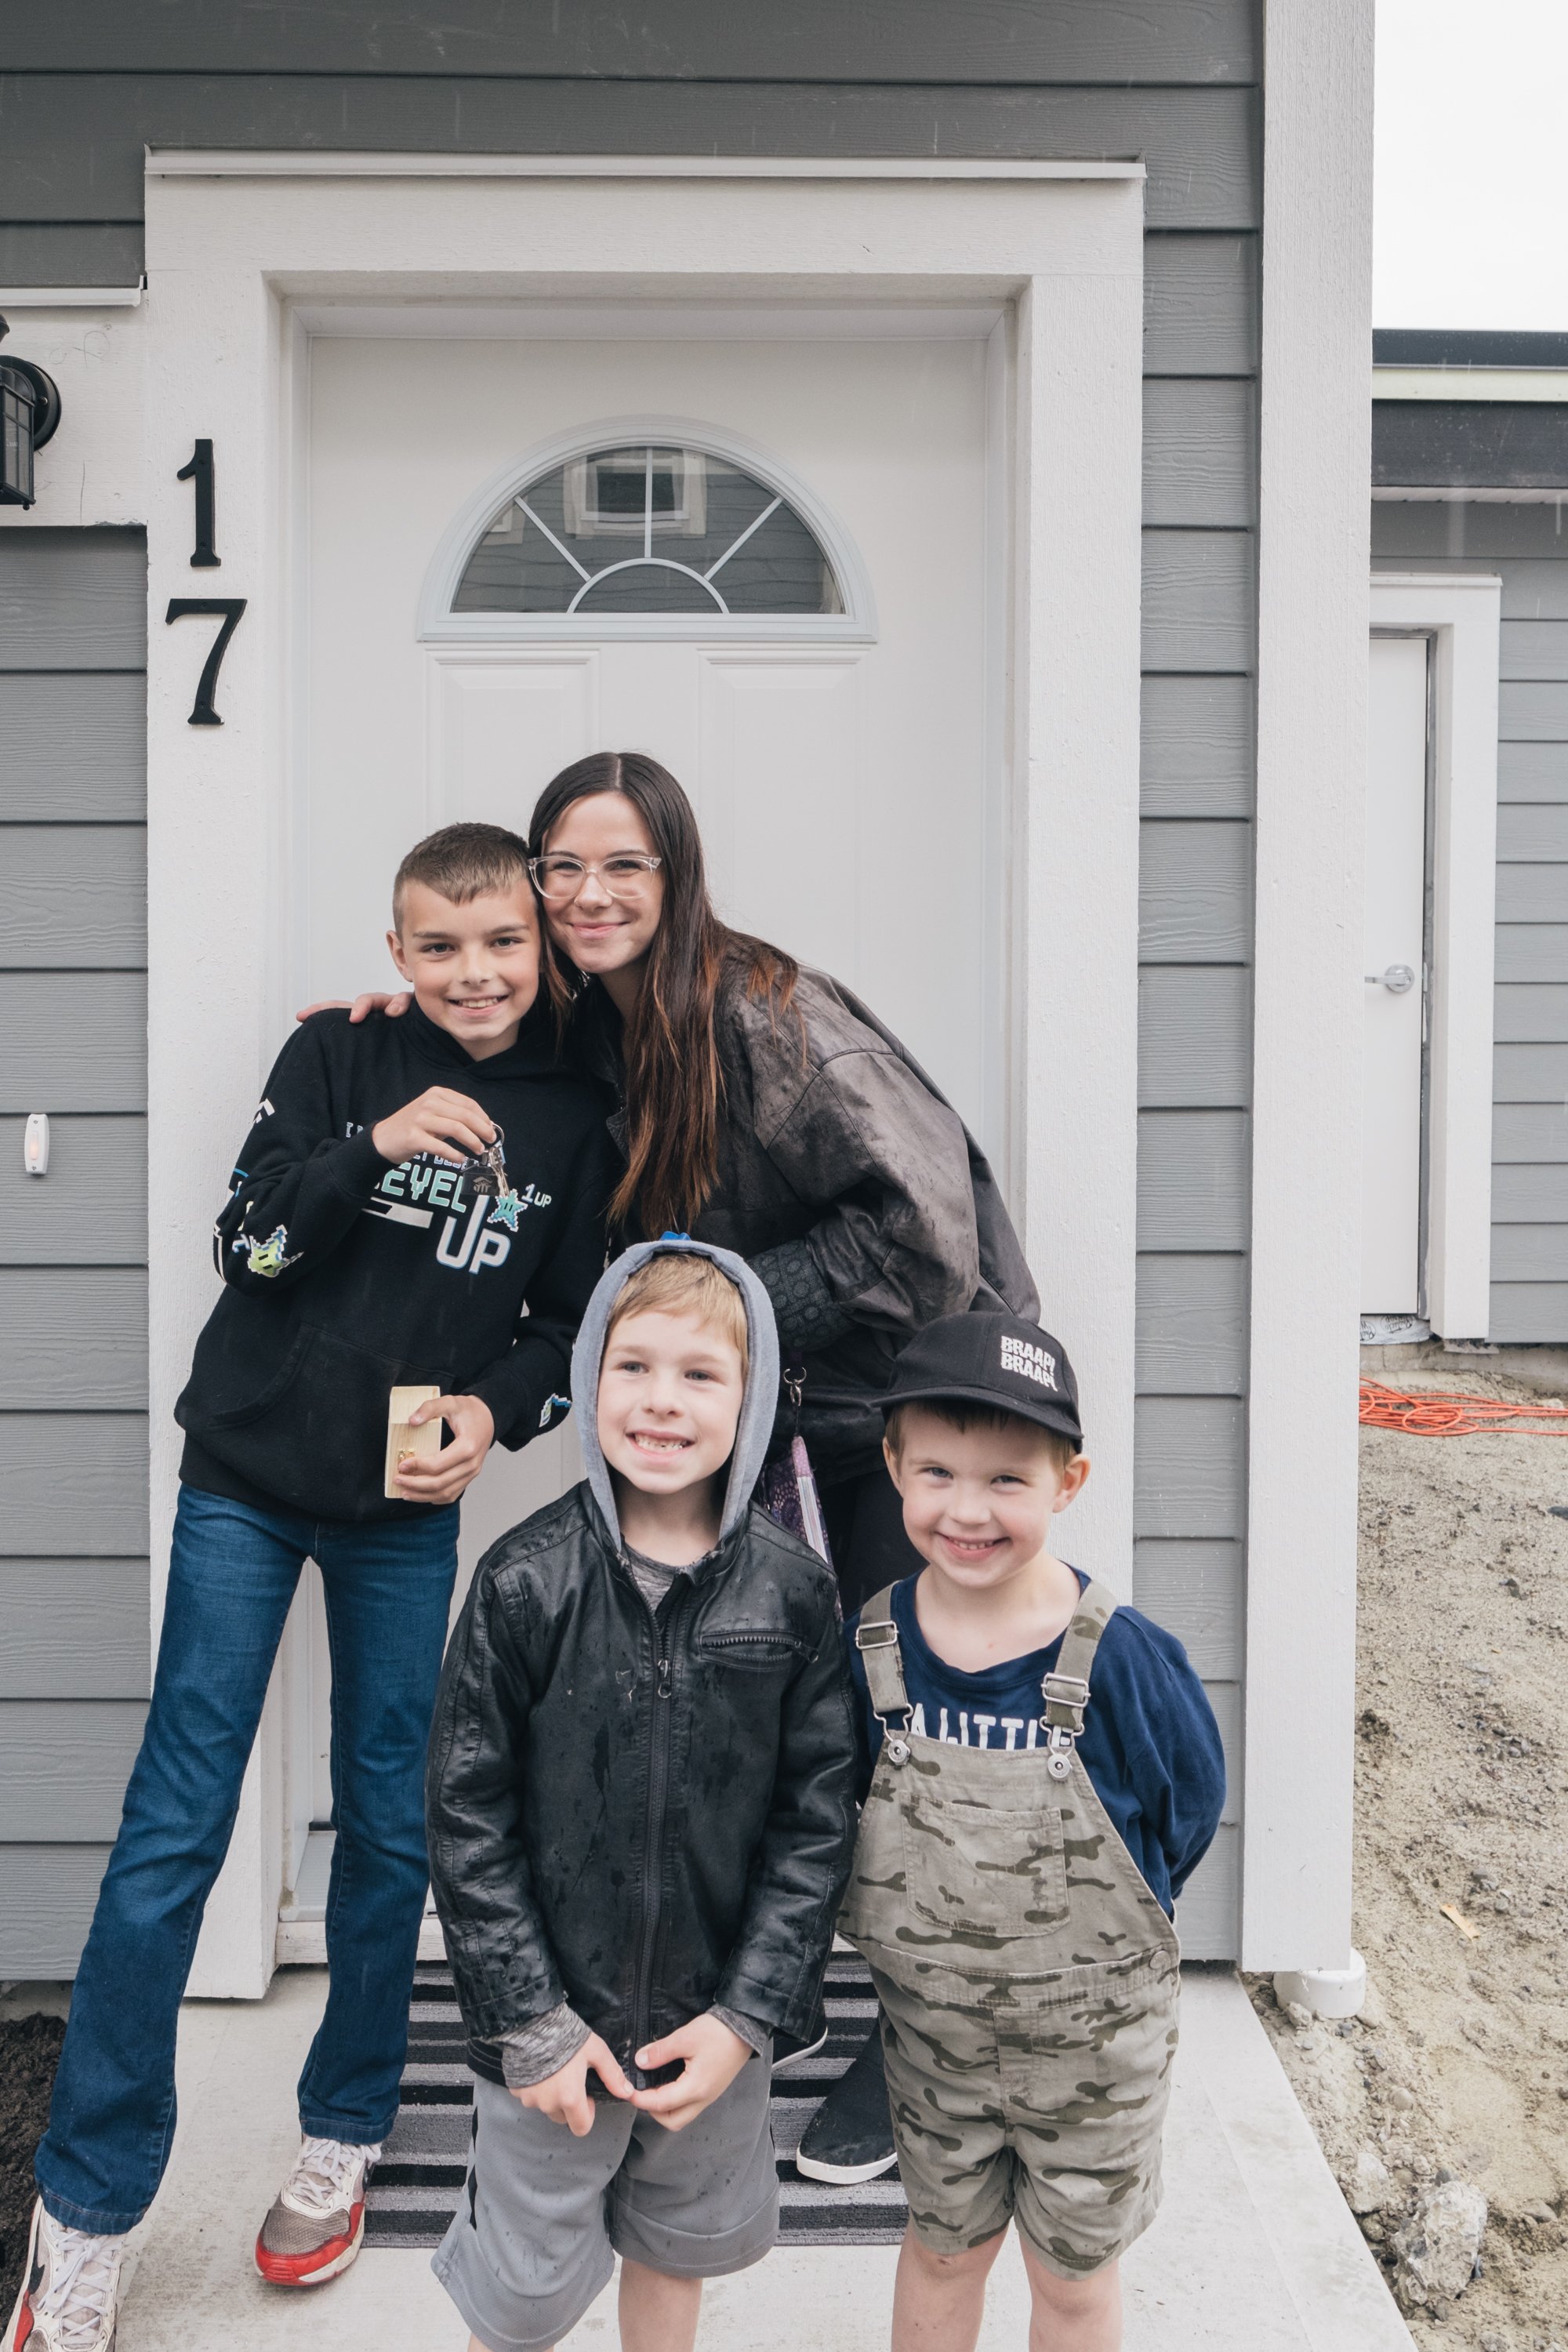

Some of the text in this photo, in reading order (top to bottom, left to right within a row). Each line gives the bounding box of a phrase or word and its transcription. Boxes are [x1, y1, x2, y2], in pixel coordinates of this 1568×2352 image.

[374, 1162, 466, 1214] EVEL
[436, 1194, 511, 1275] UP
[1001, 1335, 1056, 1377] BRAAP!
